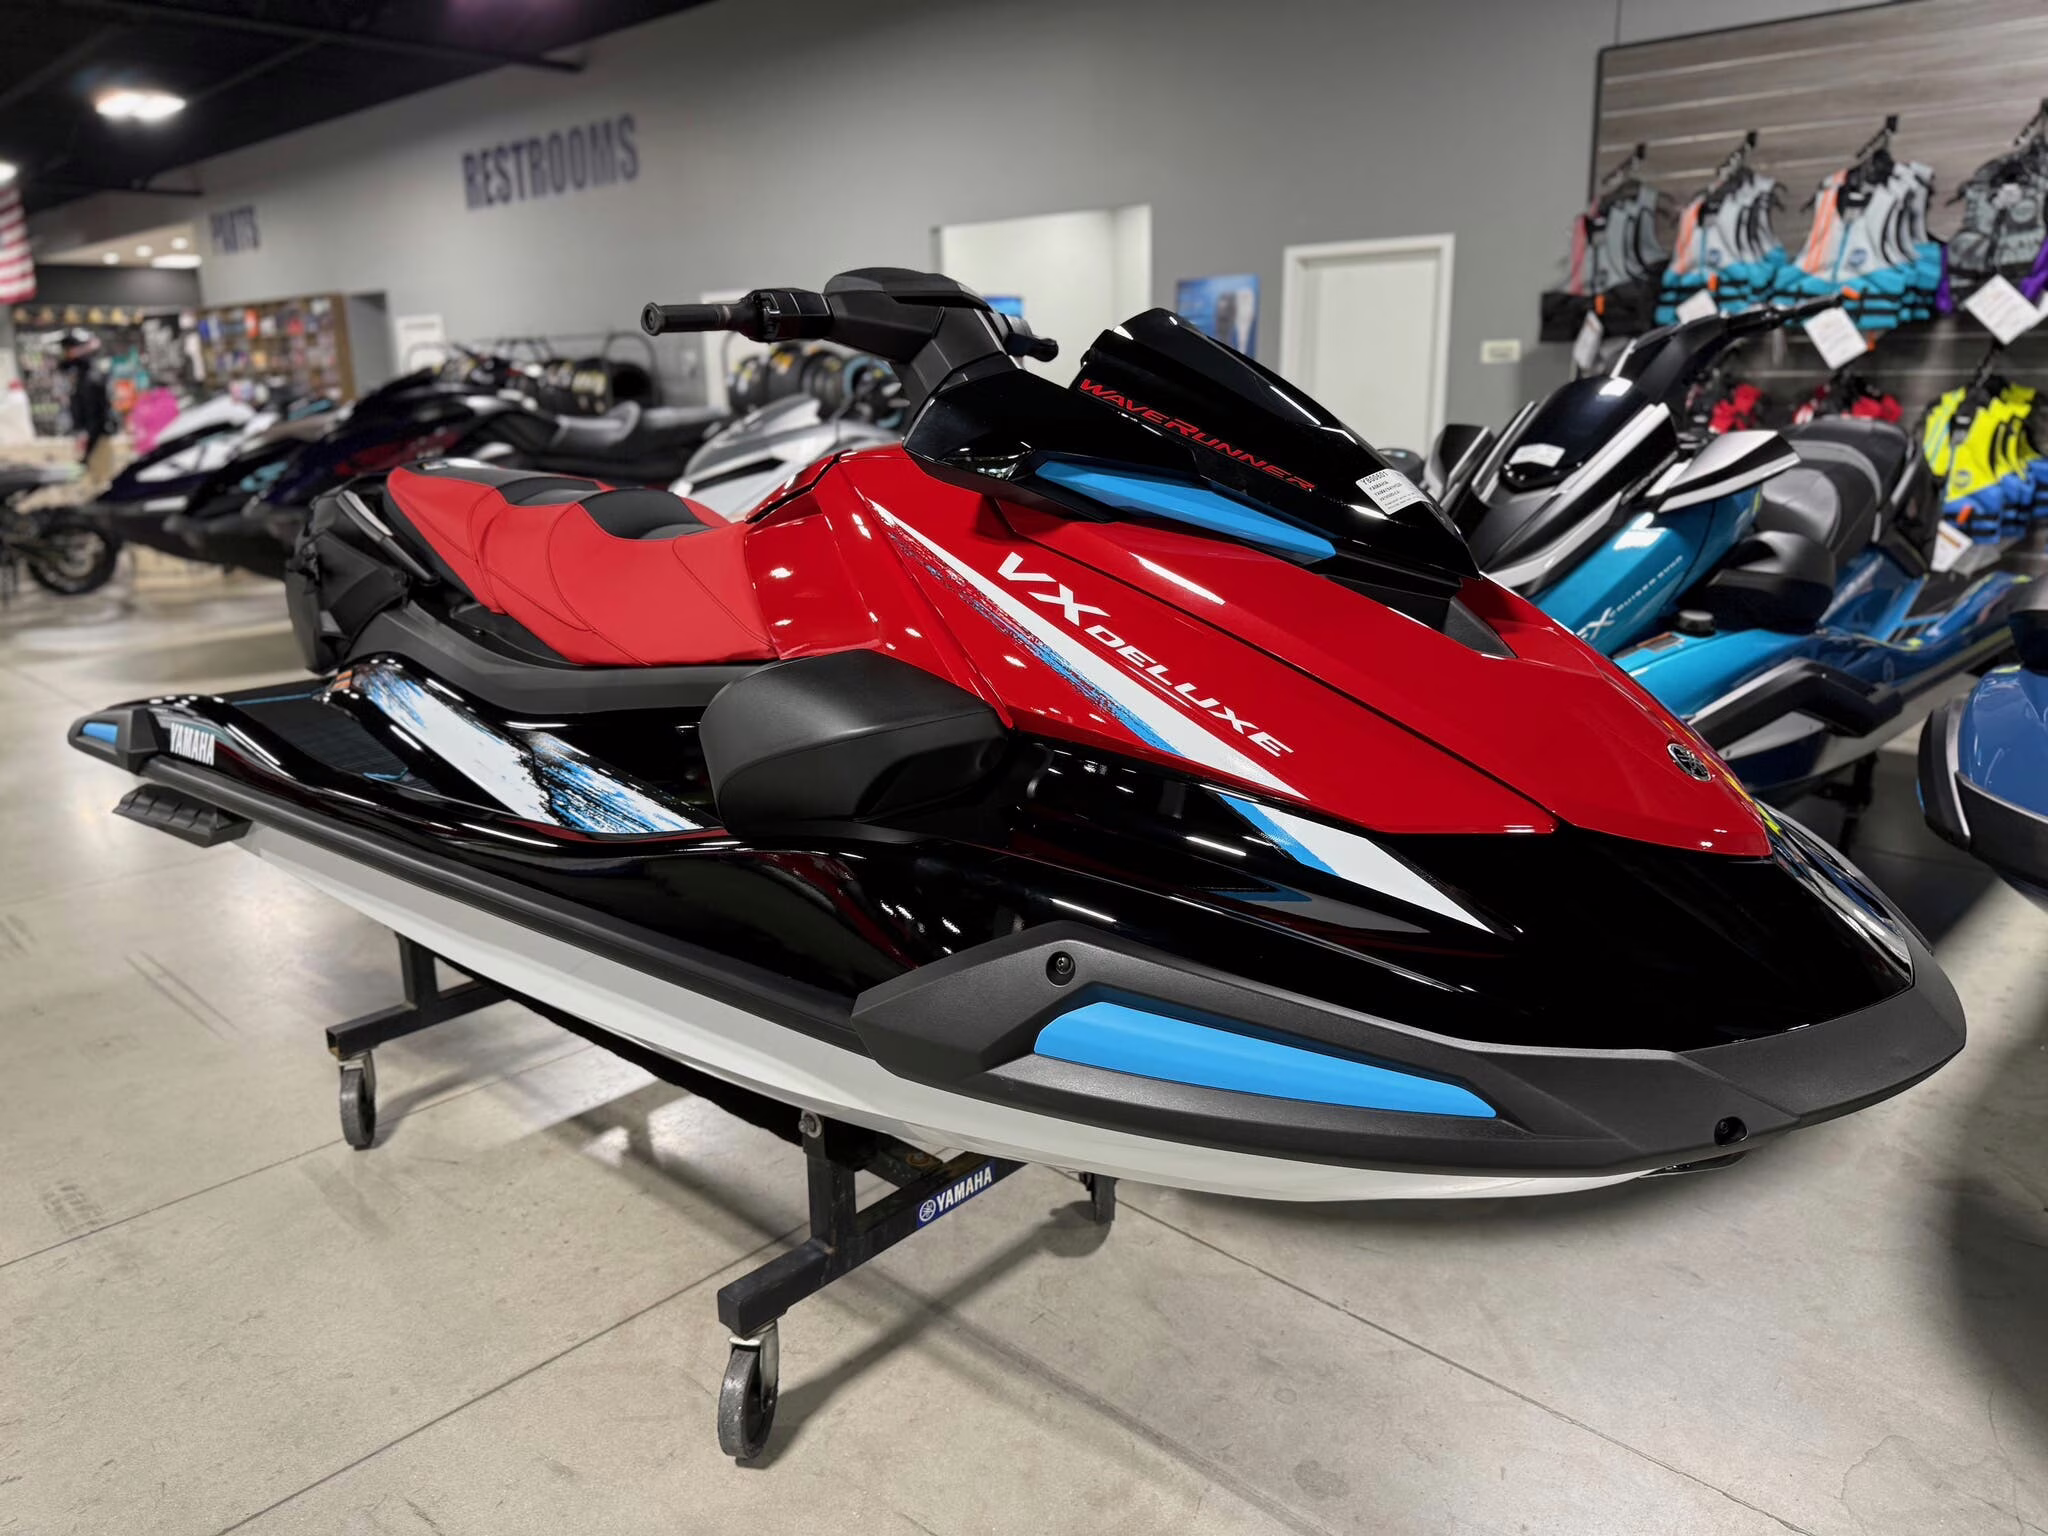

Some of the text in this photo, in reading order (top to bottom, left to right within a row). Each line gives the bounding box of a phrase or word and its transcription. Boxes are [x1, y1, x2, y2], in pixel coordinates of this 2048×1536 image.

[463, 113, 639, 212] RESTROOMS
[997, 551, 1294, 758] VX DELUXE
[170, 722, 215, 766] YAMAHA
[936, 1166, 992, 1212] YAMAHA
